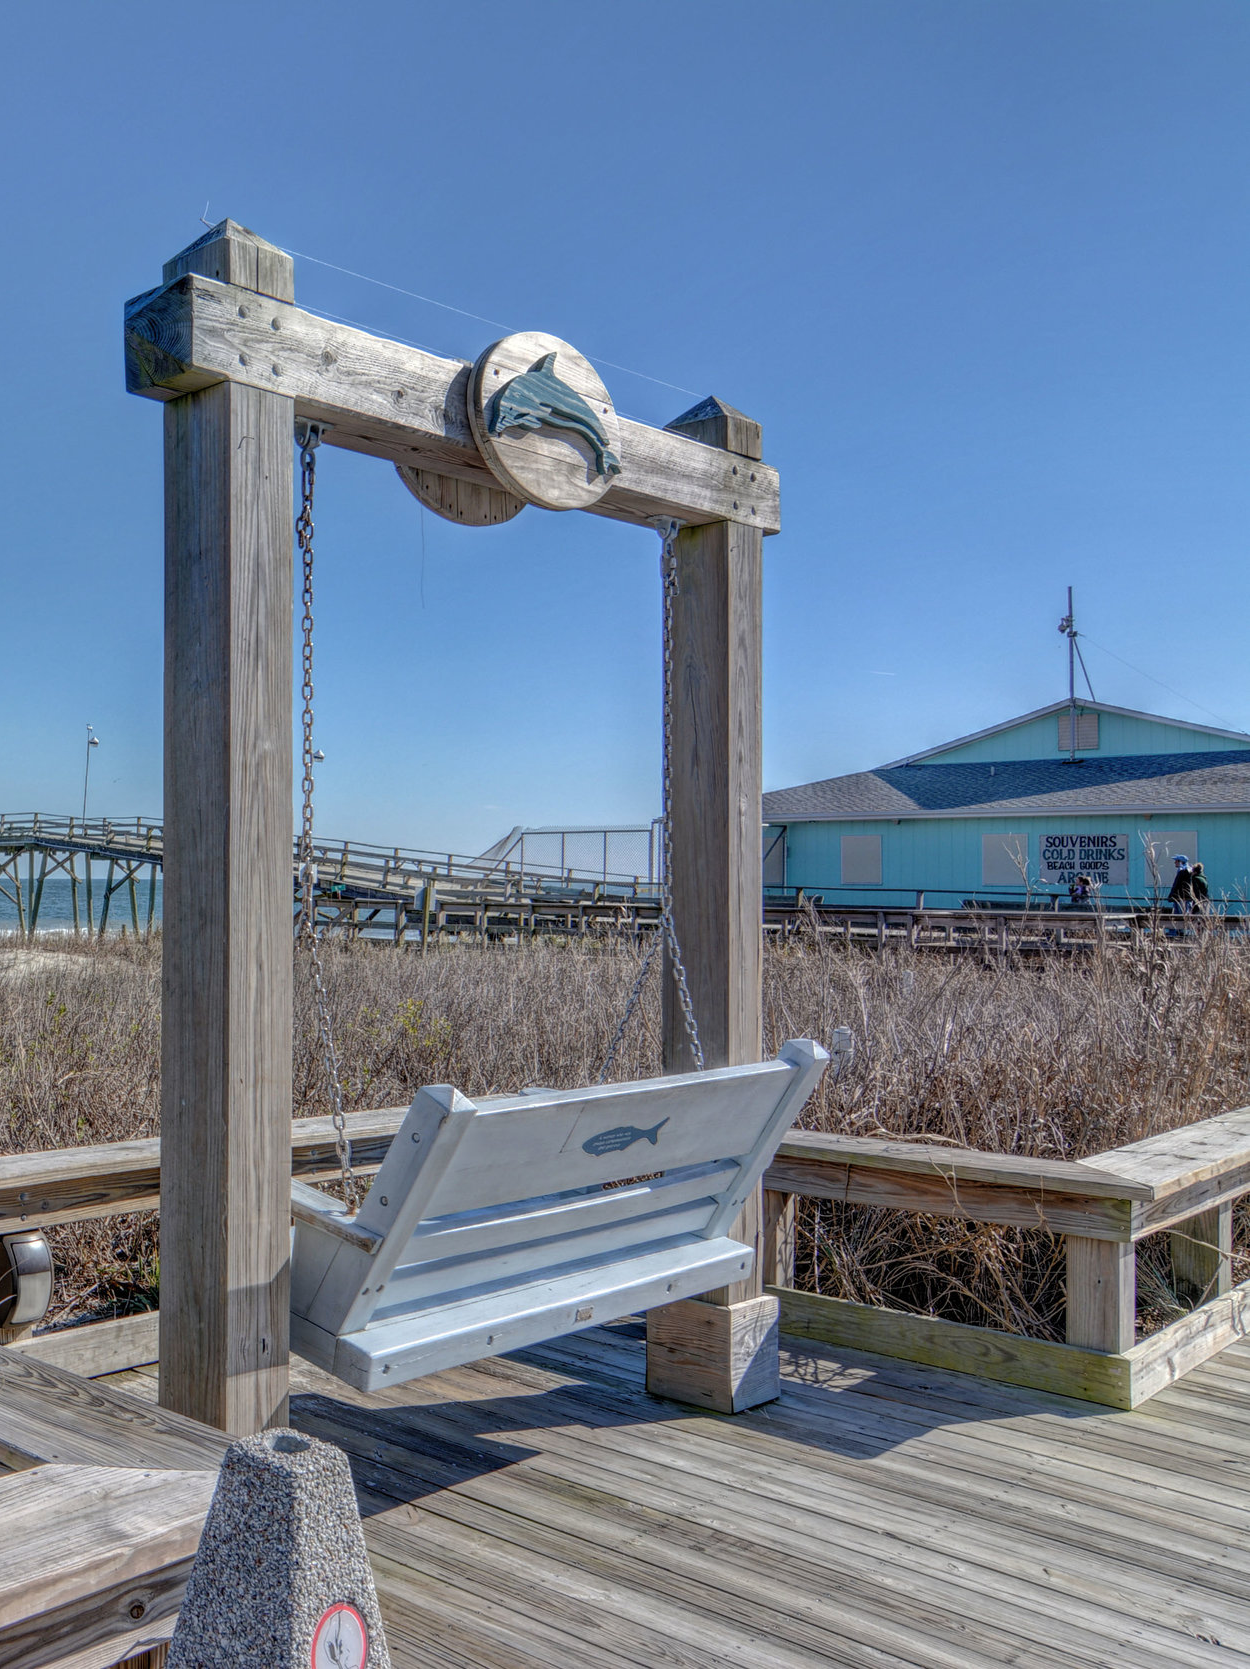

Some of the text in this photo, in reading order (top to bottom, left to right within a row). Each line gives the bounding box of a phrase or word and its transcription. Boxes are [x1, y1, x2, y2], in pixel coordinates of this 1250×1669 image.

[1045, 836, 1117, 848] SOUVENIRS
[1042, 848, 1125, 861] COLD DRINKS
[1046, 861, 1110, 870] BEACH GOODS
[1057, 872, 1109, 884] ARDE
